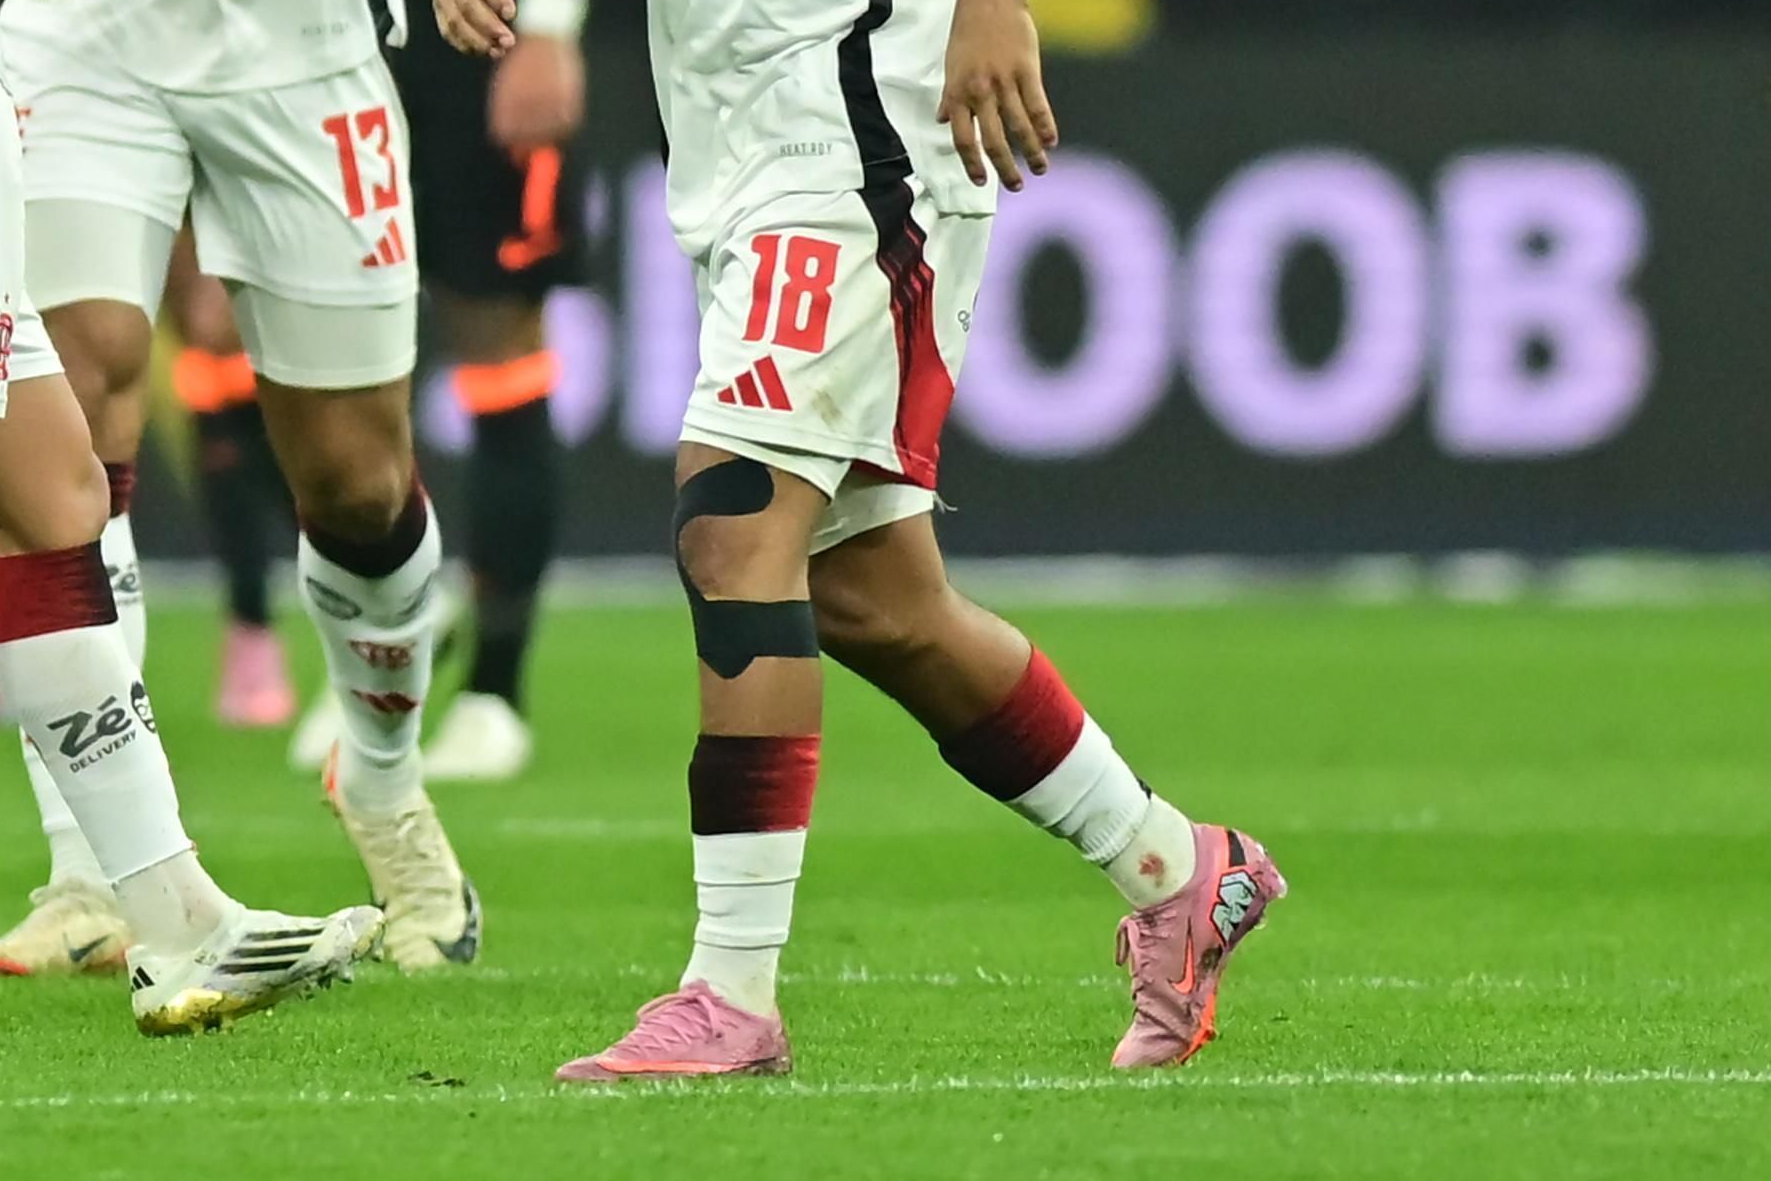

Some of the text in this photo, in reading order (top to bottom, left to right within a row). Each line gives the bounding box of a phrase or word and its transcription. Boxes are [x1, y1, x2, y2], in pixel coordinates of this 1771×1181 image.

[321, 107, 399, 220] 13
[741, 234, 842, 354] 18
[47, 696, 133, 759] Zé
[70, 729, 137, 773] DELIVERY
